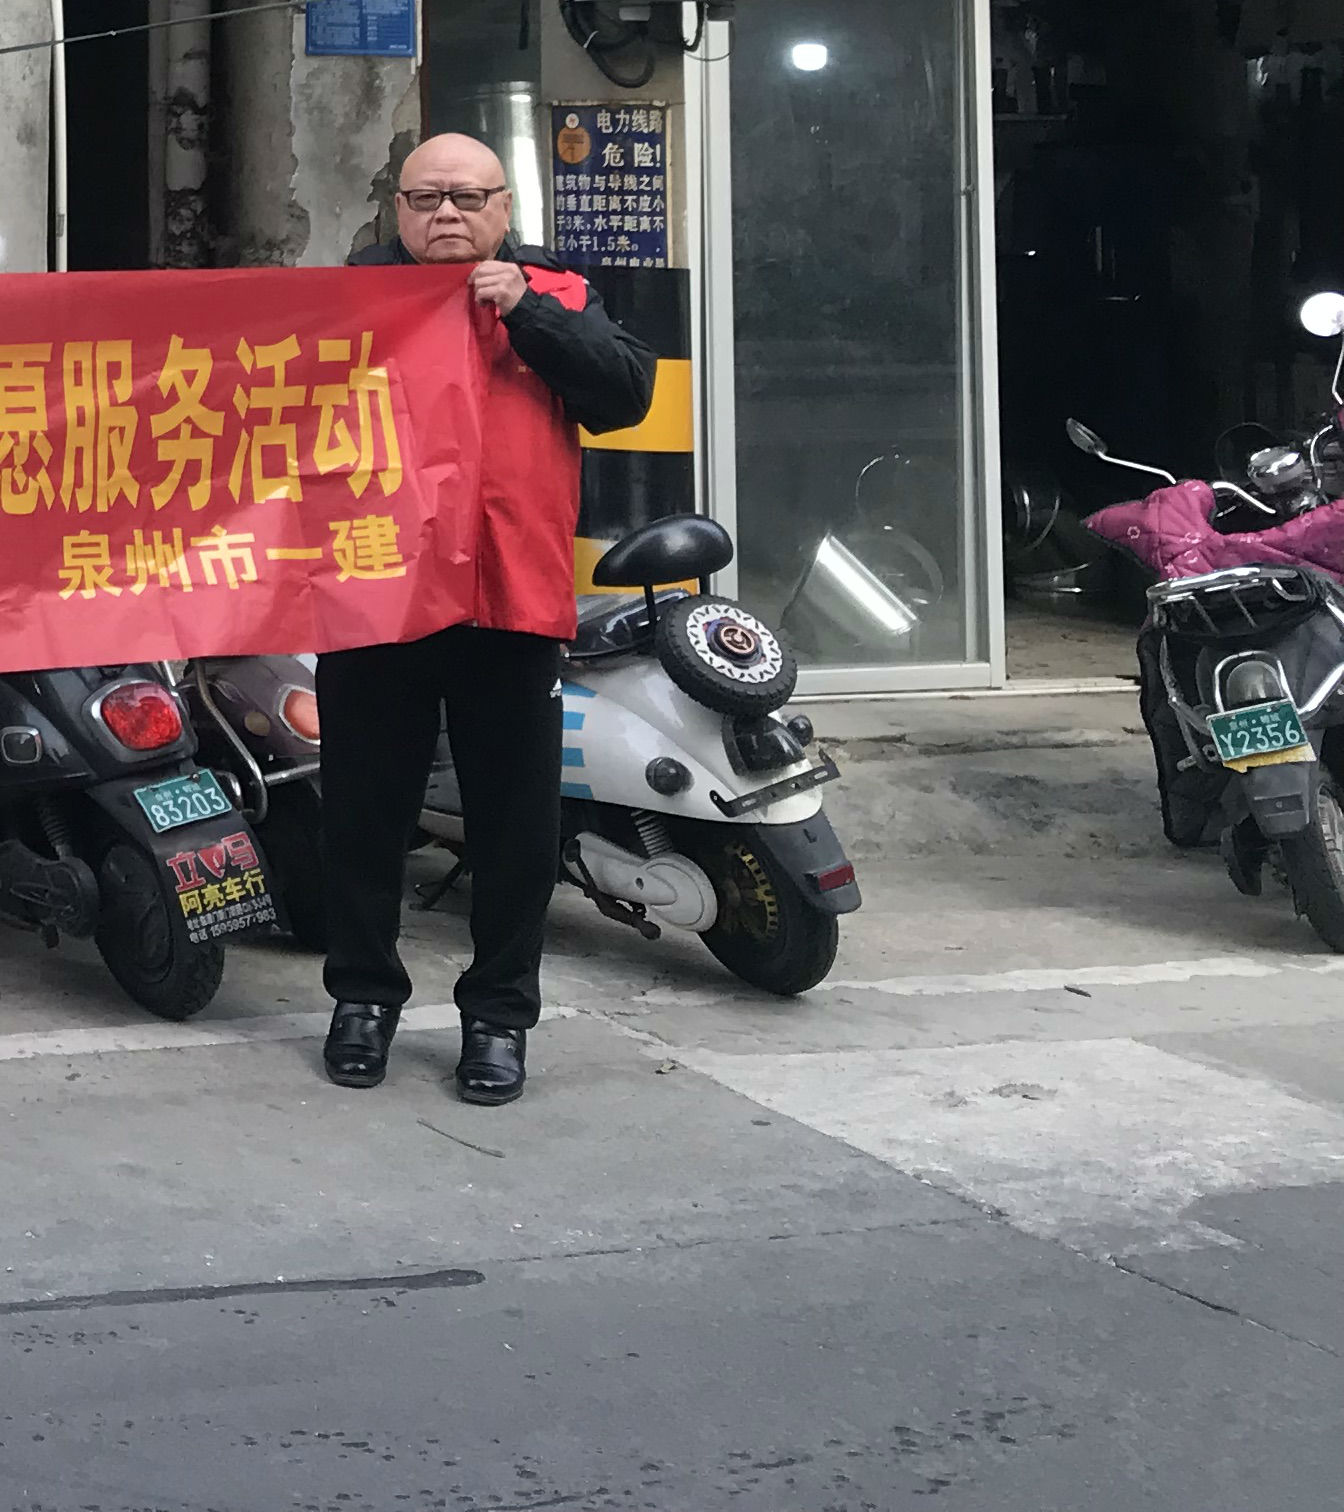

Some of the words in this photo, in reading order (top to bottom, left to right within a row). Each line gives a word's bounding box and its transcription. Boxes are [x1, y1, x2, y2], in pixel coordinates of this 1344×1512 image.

[597, 109, 663, 134] 电力线路
[56, 514, 408, 601] 泉州市一建
[1219, 720, 1301, 756] Y2356
[150, 787, 226, 827] 83203
[178, 868, 265, 917] 阿亮车行
